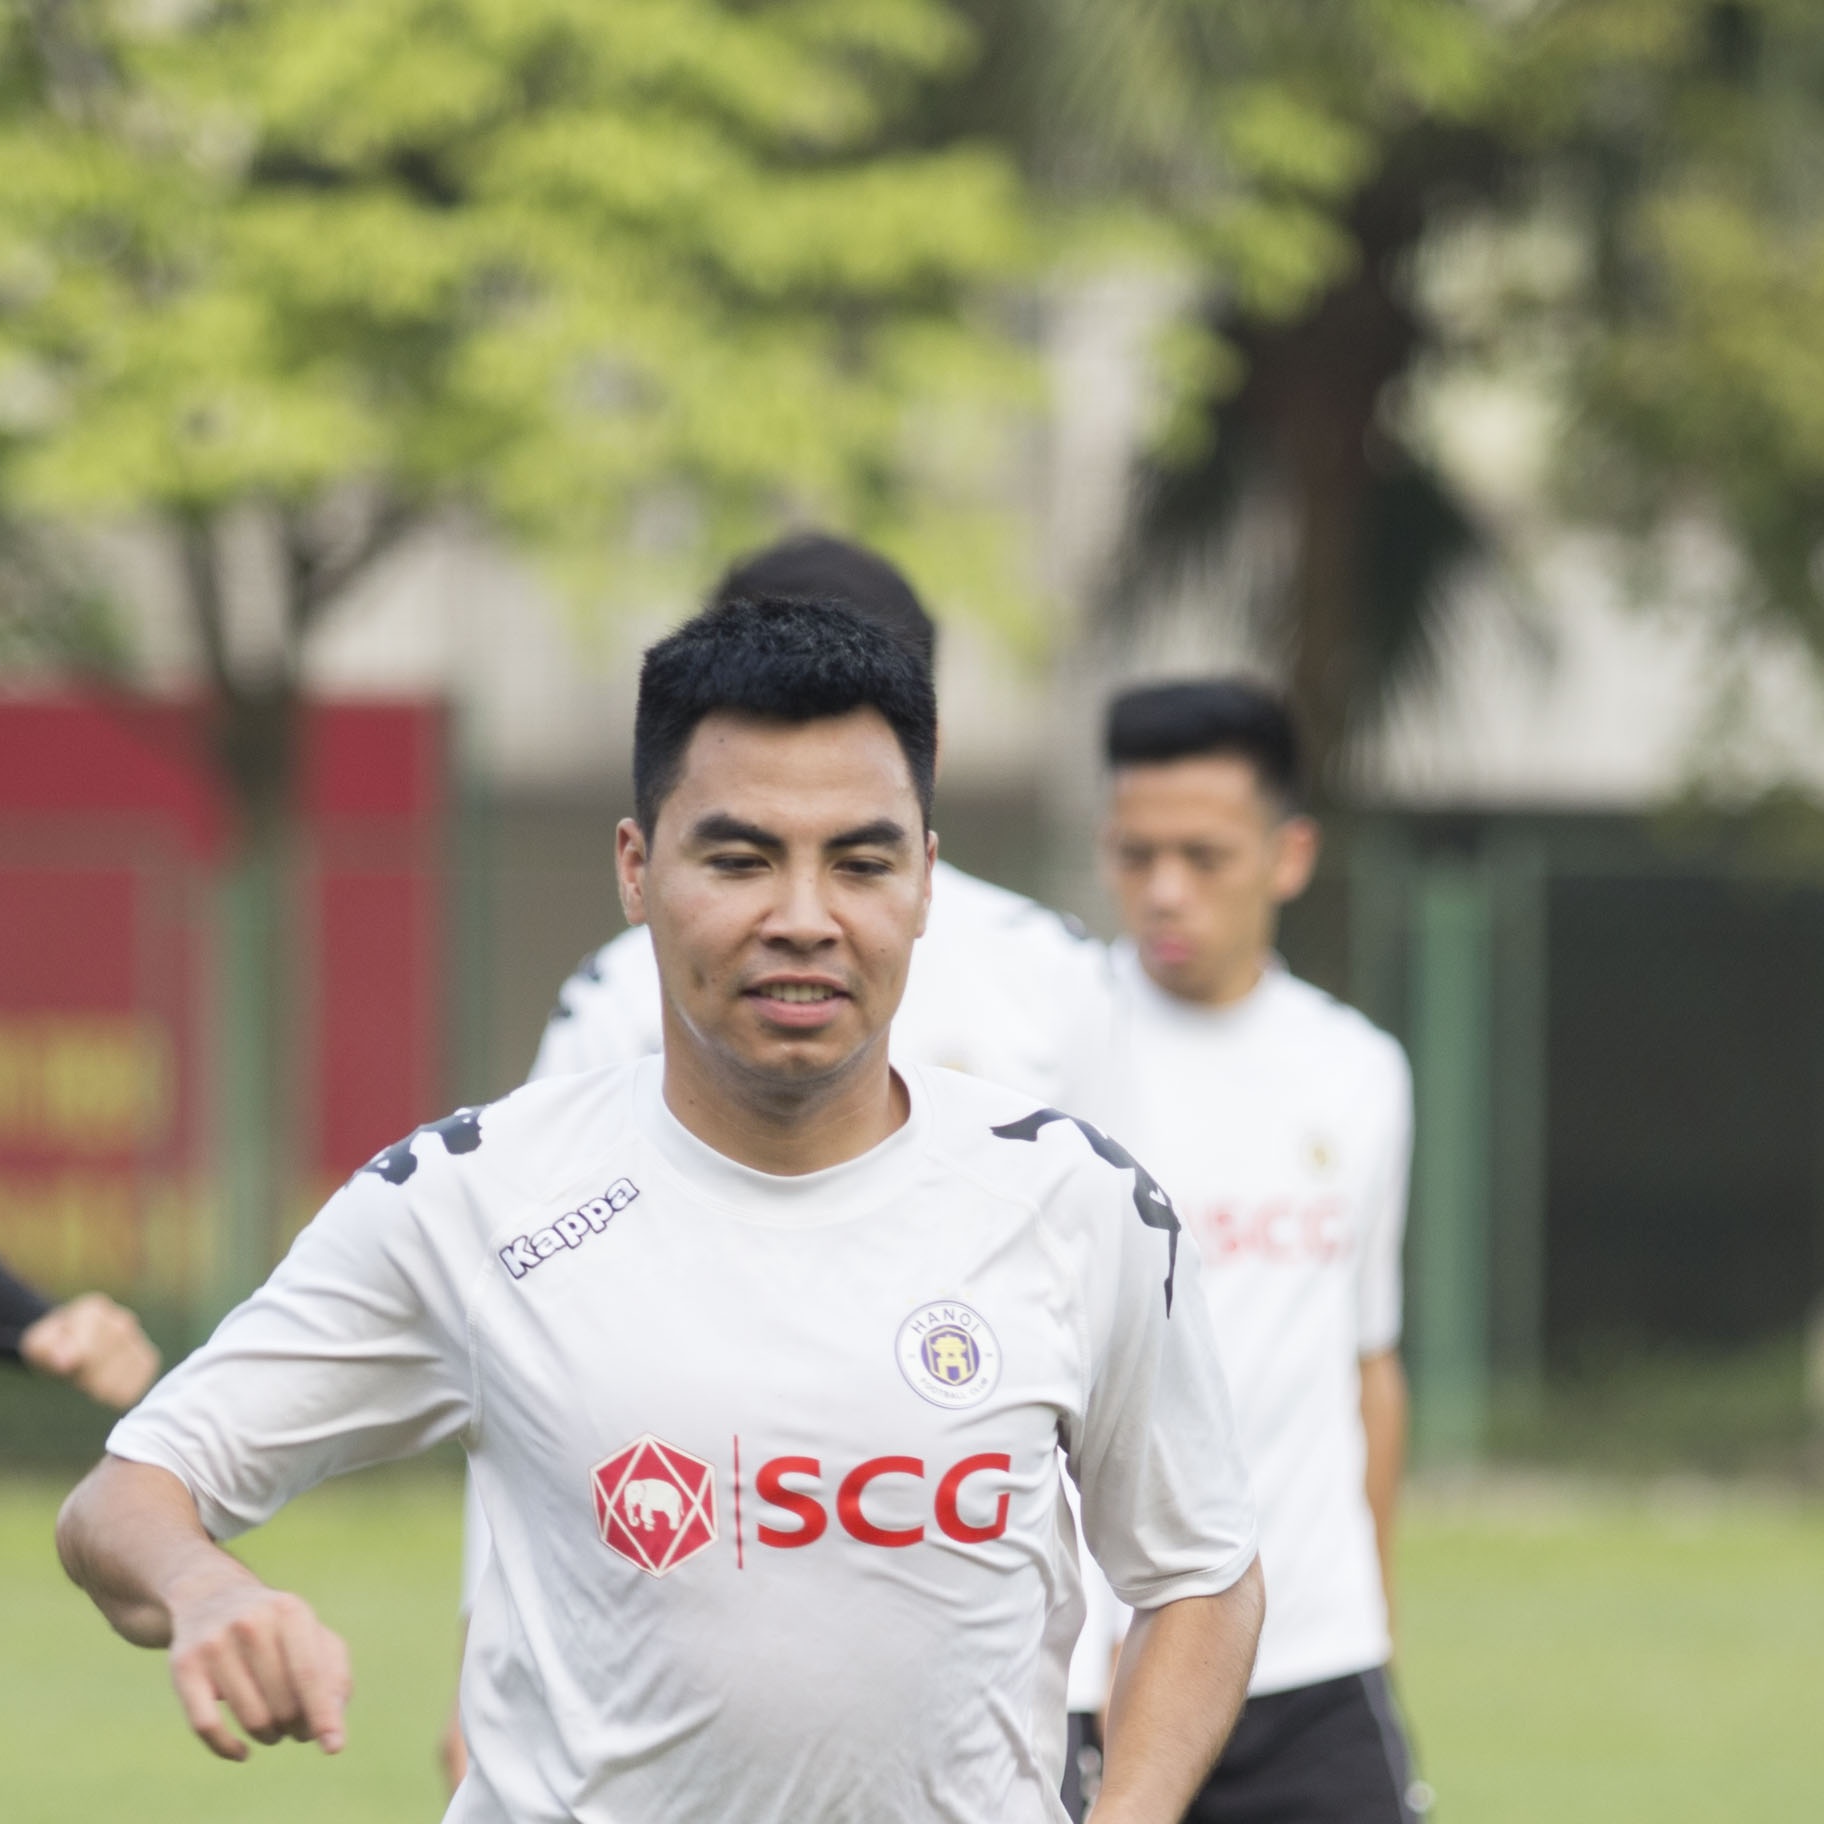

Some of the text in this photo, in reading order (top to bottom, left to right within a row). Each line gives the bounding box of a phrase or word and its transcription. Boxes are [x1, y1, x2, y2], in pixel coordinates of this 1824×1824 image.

[498, 1177, 640, 1280] Kappa
[910, 1307, 980, 1335] HANOI
[755, 1452, 1011, 1549] SCG
